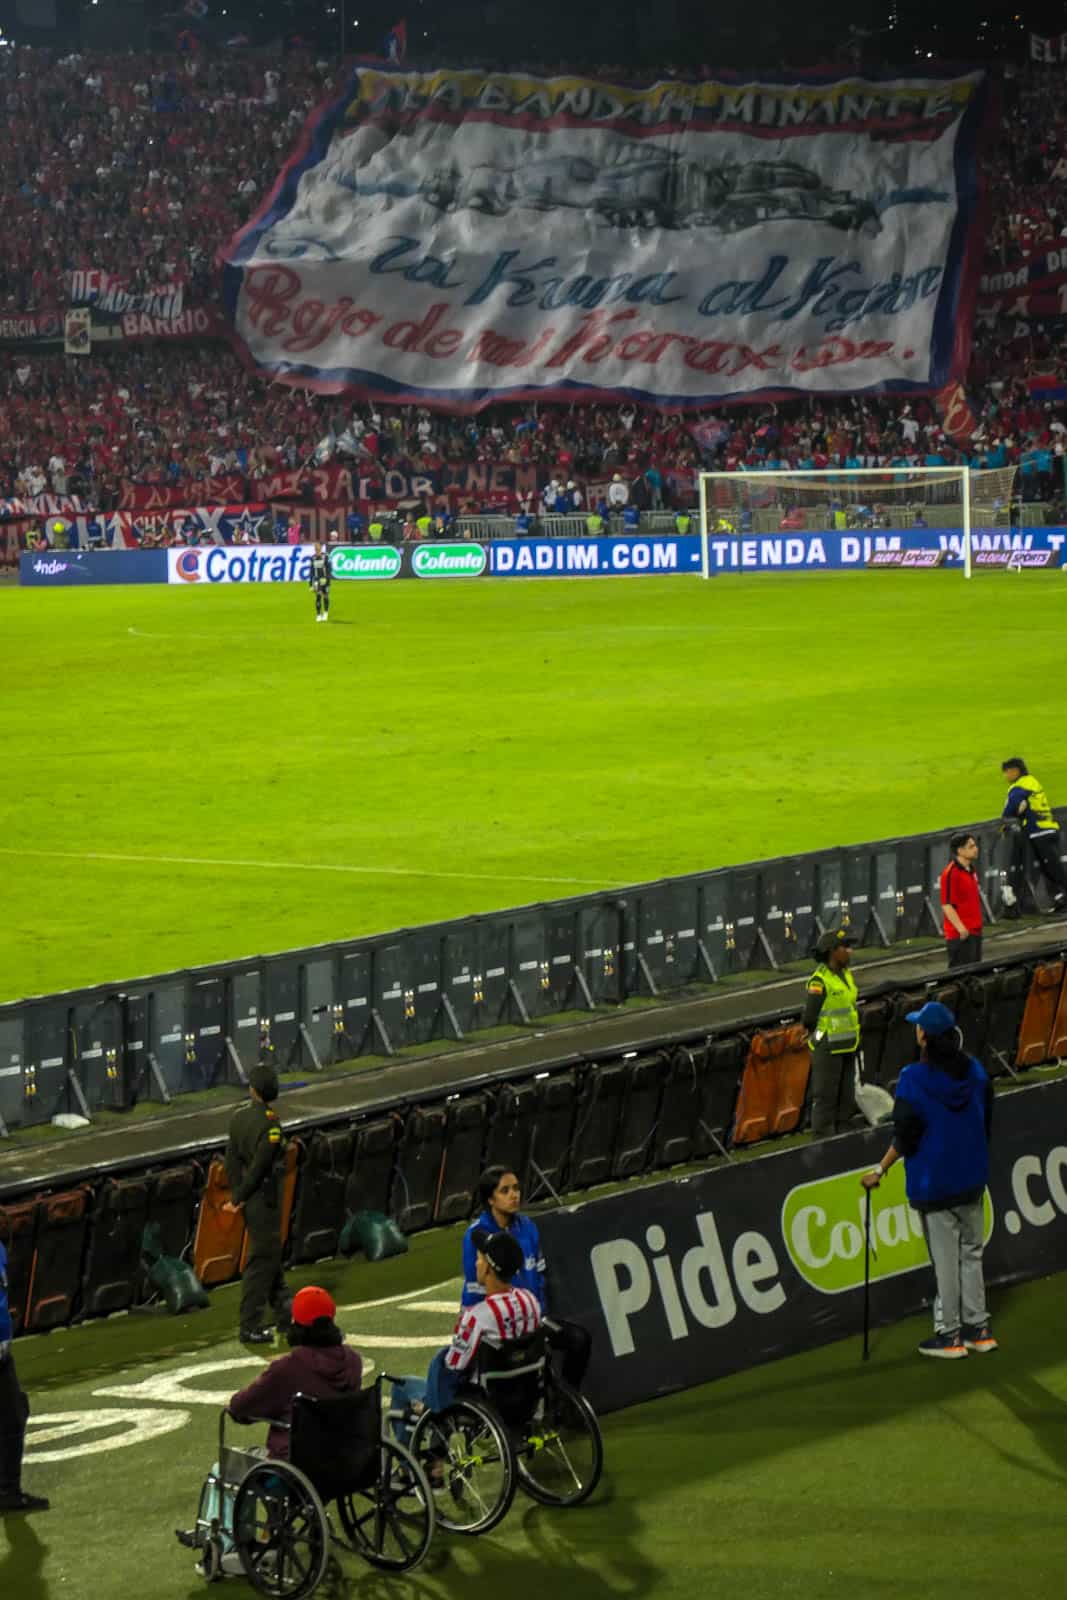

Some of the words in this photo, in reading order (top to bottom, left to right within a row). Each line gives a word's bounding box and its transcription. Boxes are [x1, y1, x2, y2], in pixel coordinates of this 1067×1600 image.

[382, 302, 465, 359] de
[331, 553, 398, 573] Colanta
[414, 548, 482, 569] Colanta
[712, 537, 826, 567] TIENDA
[590, 1211, 788, 1357] Pide
